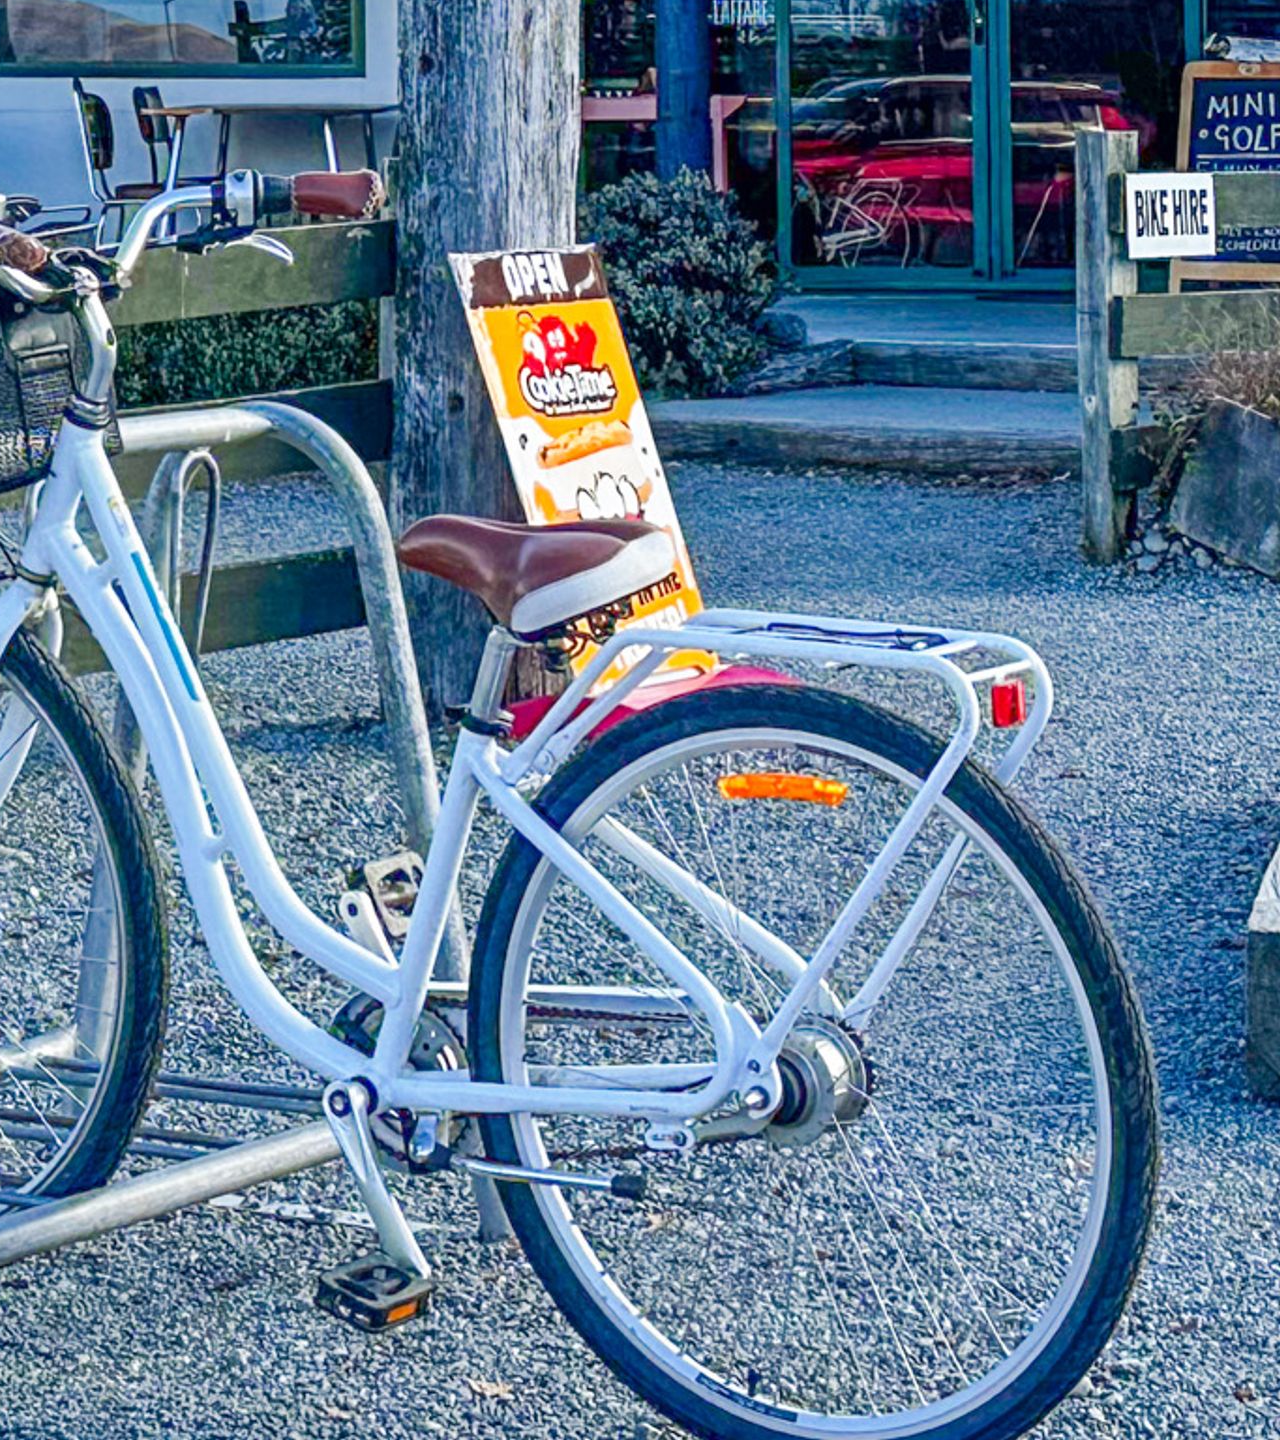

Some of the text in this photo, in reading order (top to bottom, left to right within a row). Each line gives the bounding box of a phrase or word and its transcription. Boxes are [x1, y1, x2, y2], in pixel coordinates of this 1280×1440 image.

[1206, 91, 1275, 119] MINI
[1214, 124, 1280, 151] GOLF
[1134, 188, 1209, 237] BIKE HIRE
[502, 252, 569, 298] OPEN
